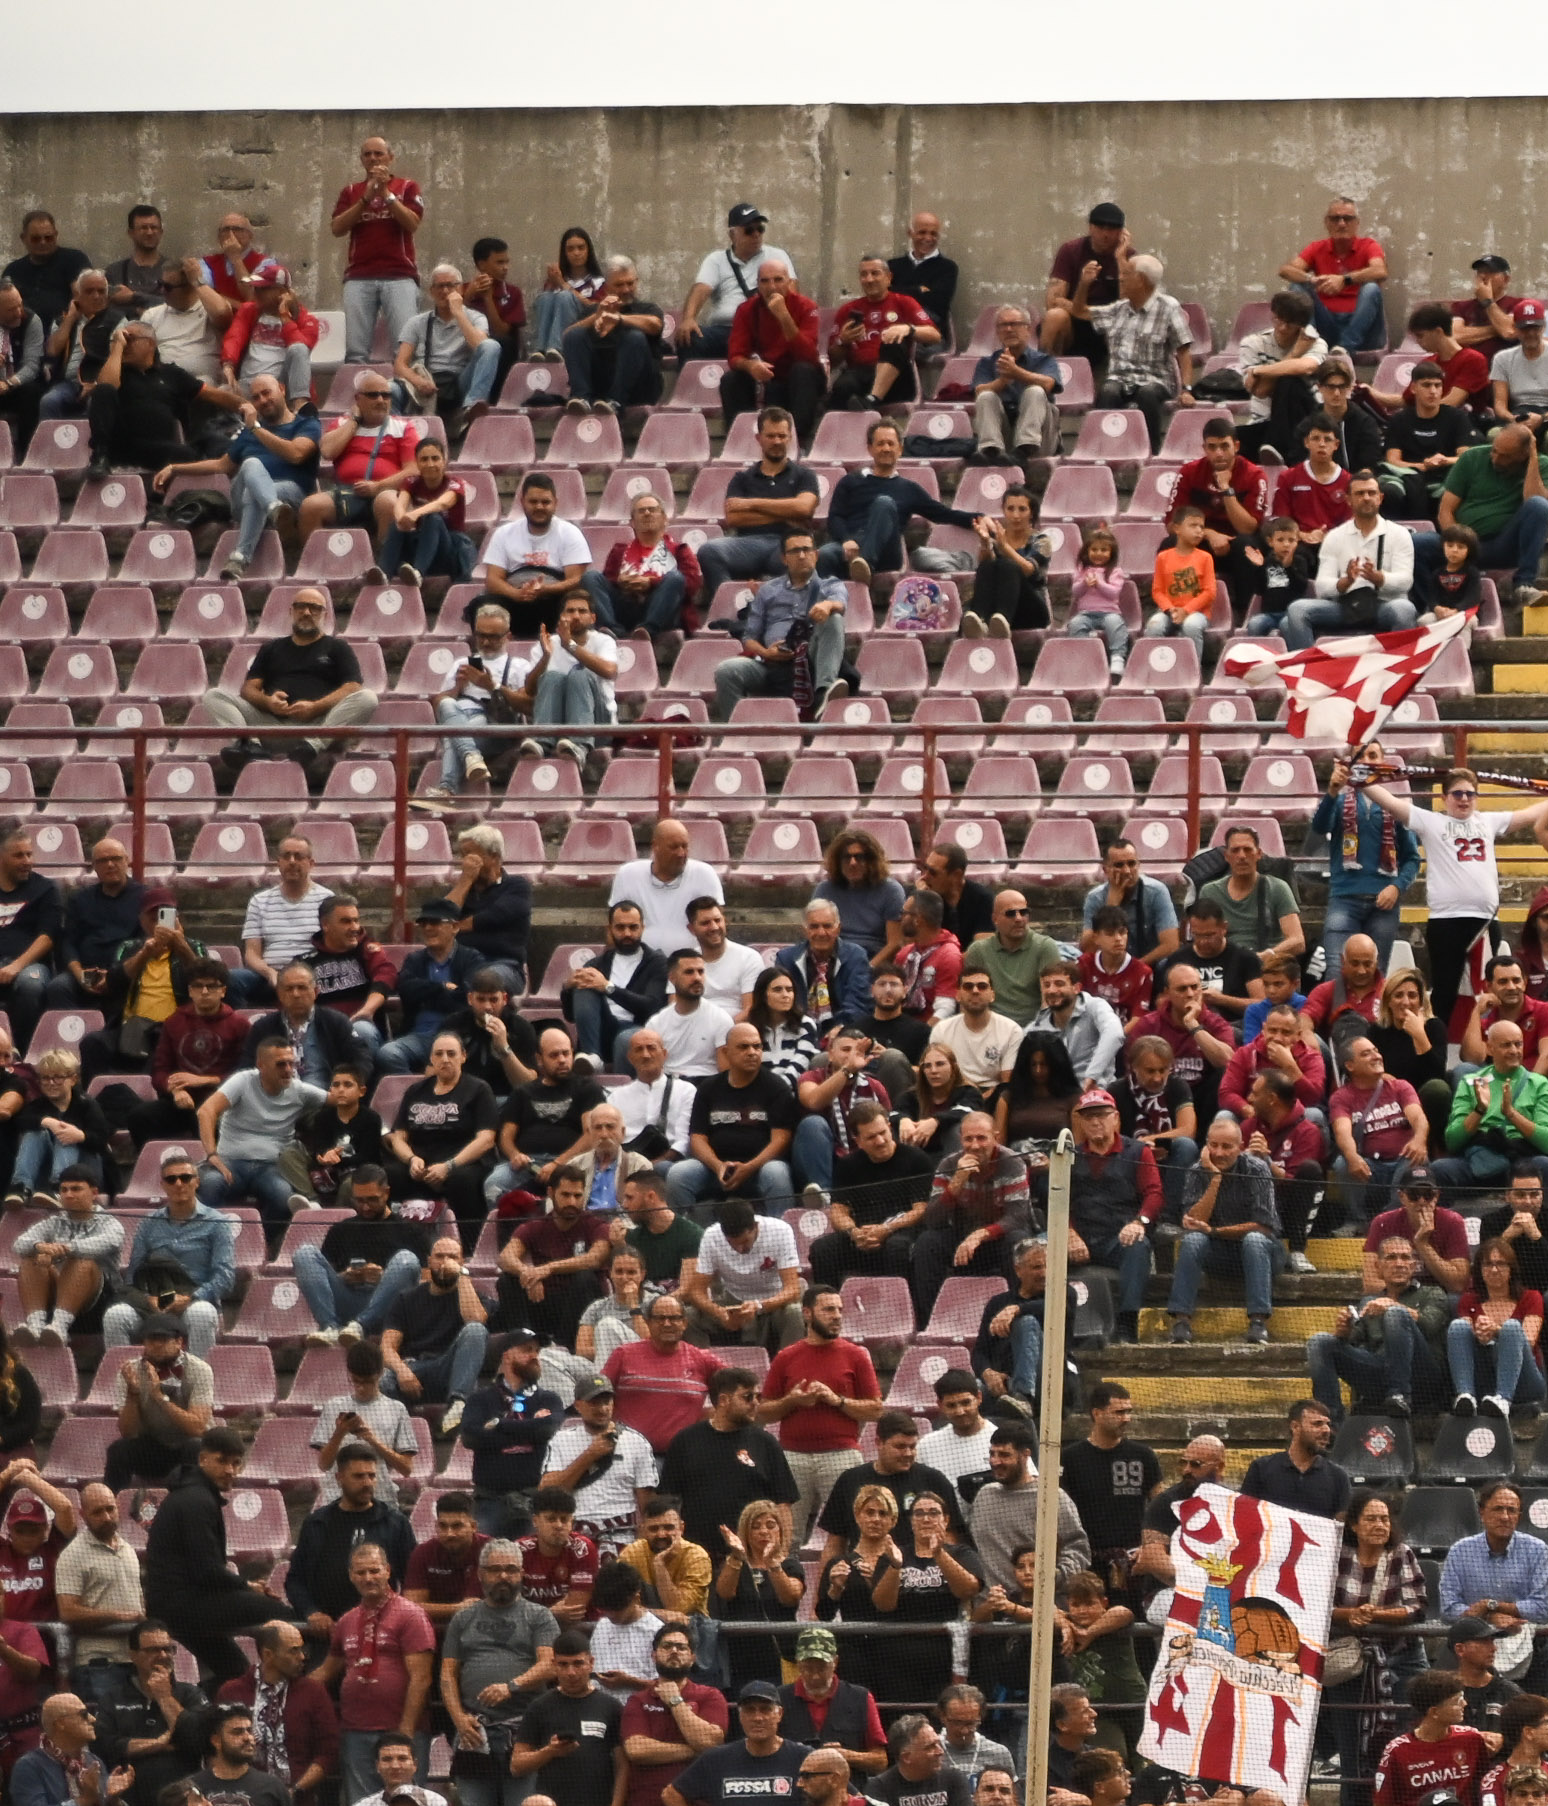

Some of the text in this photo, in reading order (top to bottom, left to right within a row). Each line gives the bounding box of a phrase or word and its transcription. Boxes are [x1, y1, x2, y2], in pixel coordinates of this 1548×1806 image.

[1455, 837, 1487, 862] 23
[1111, 1459, 1145, 1487] 89
[725, 1781, 771, 1794] FOSSA
[1410, 1770, 1471, 1788] CANALE
